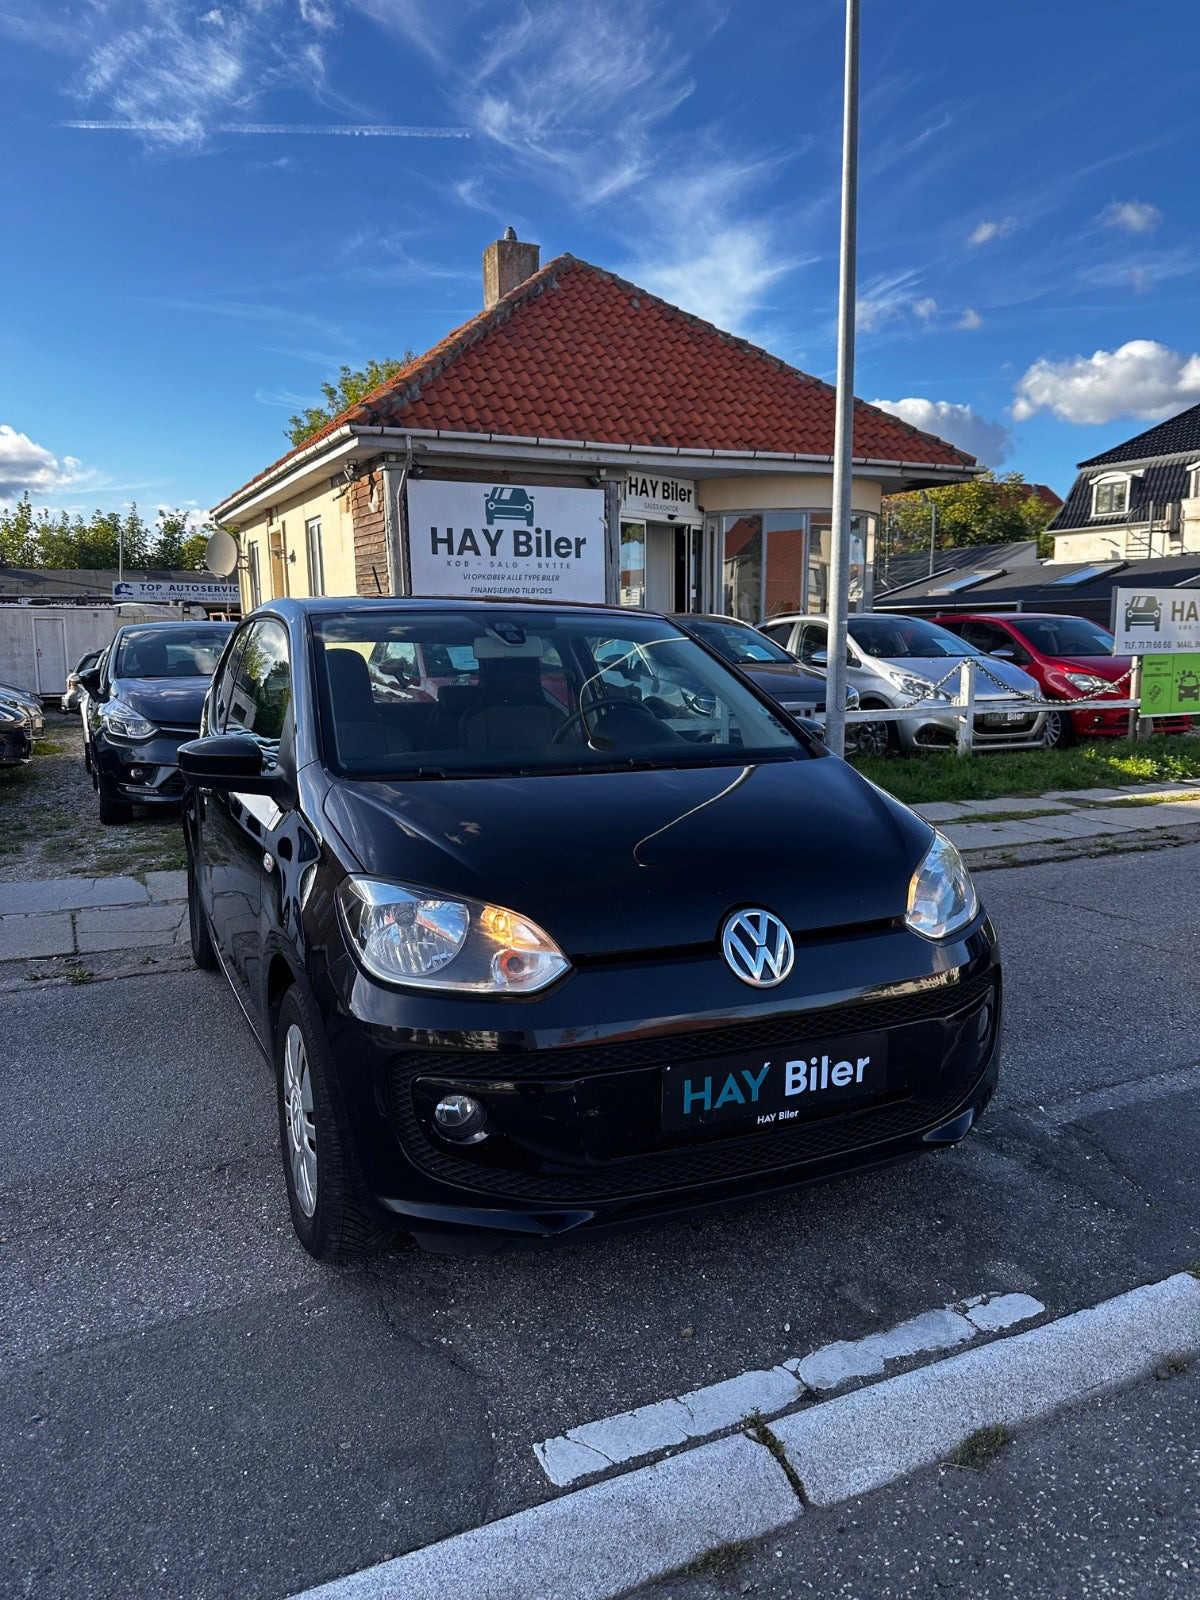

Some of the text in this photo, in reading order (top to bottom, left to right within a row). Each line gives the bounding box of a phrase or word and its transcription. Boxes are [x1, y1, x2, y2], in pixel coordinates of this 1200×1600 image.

[629, 476, 692, 503] HAY Biler
[430, 527, 587, 559] HAY Biler
[139, 584, 239, 592] TOP AUTOSERVIC
[470, 586, 553, 595] FINANSIERING TILBYDES
[1171, 601, 1199, 621] HA
[1007, 712, 1025, 721] Biler
[683, 1055, 871, 1114] HAY Biler
[757, 1109, 799, 1125] HAY Biler
